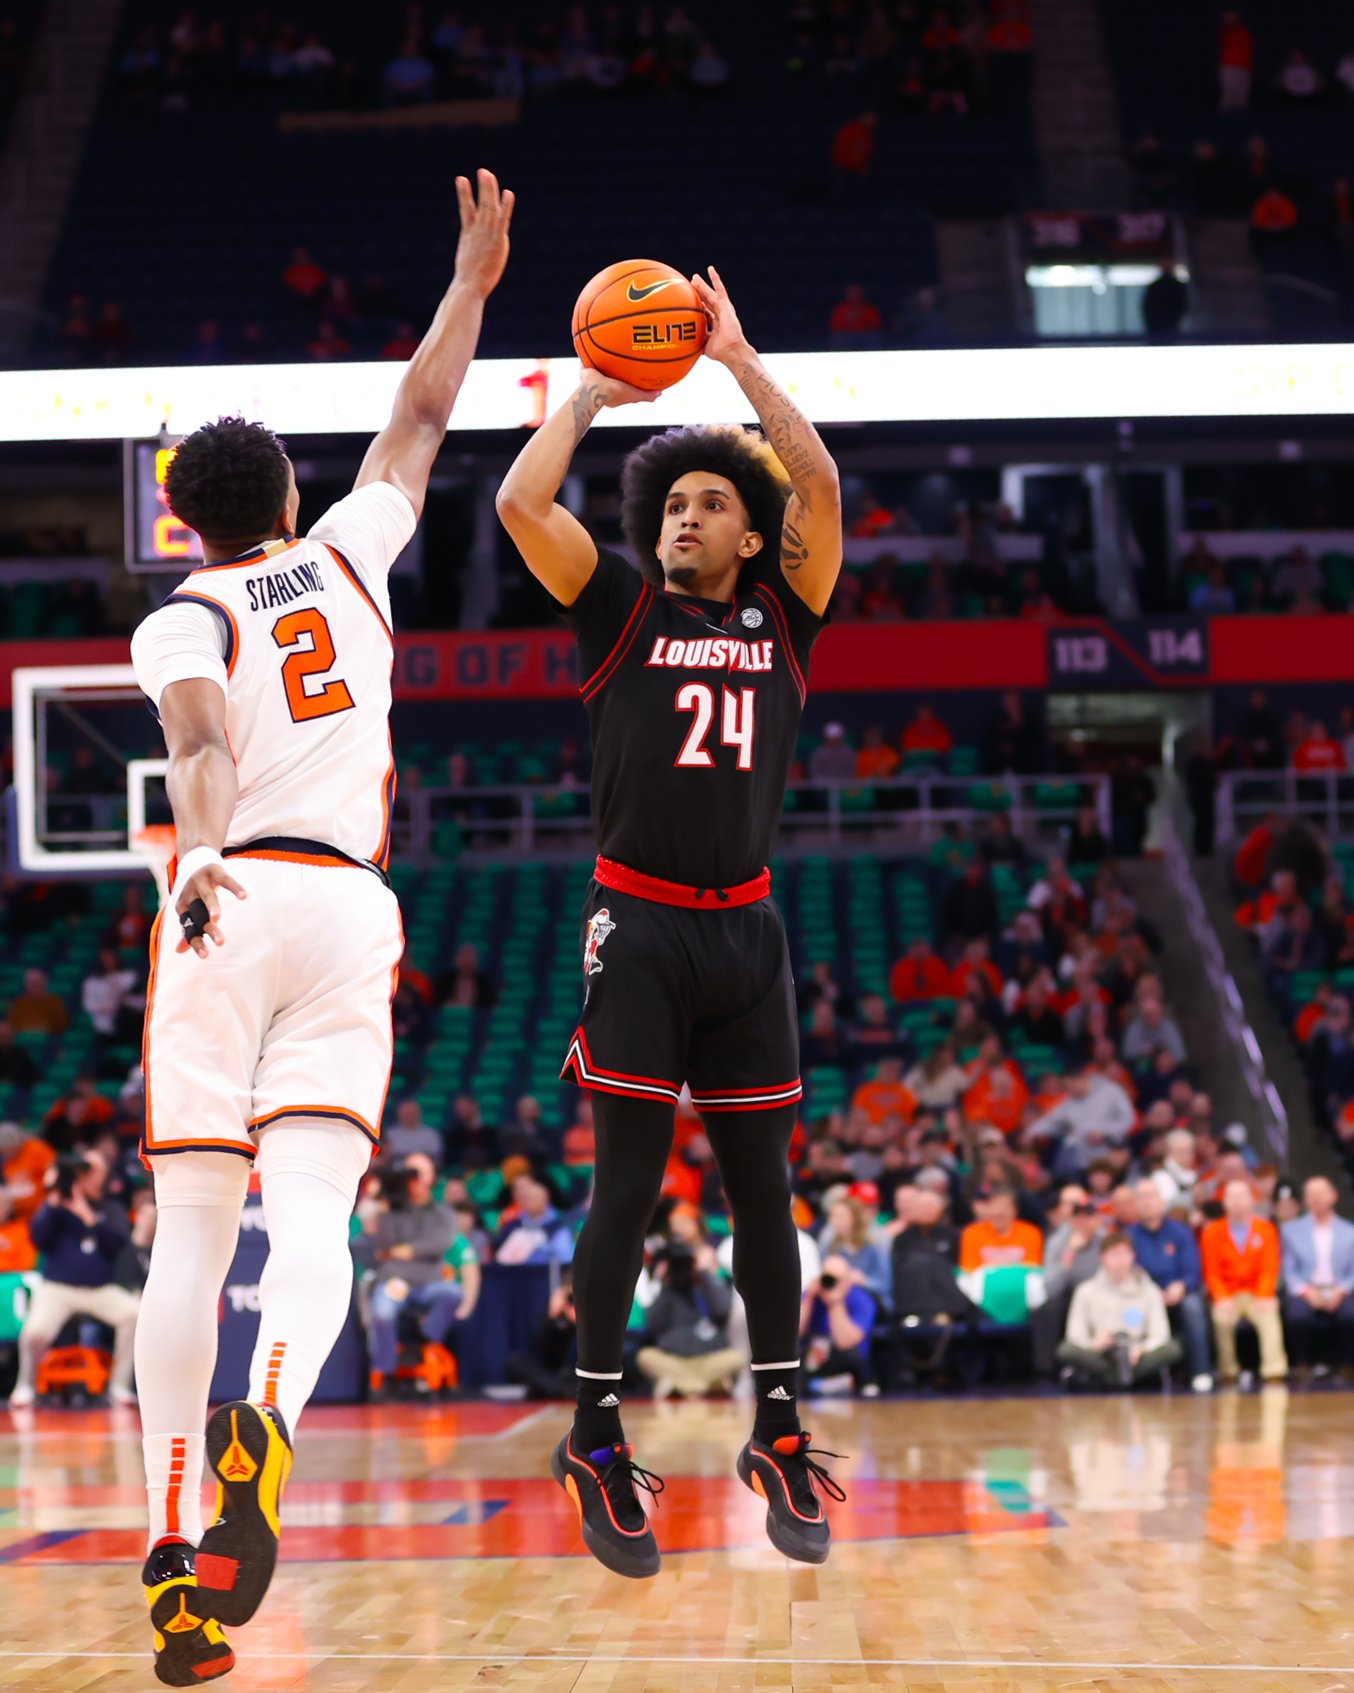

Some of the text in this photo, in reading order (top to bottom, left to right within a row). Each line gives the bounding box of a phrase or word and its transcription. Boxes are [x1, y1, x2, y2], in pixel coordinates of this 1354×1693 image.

[632, 321, 696, 343] ELITE
[245, 560, 325, 612] STARLING
[270, 606, 356, 723] 2
[457, 644, 527, 686] OF
[643, 636, 774, 675] LOUISVILLE
[1056, 637, 1108, 672] 113
[1148, 629, 1202, 664] 114
[673, 681, 757, 771] 24
